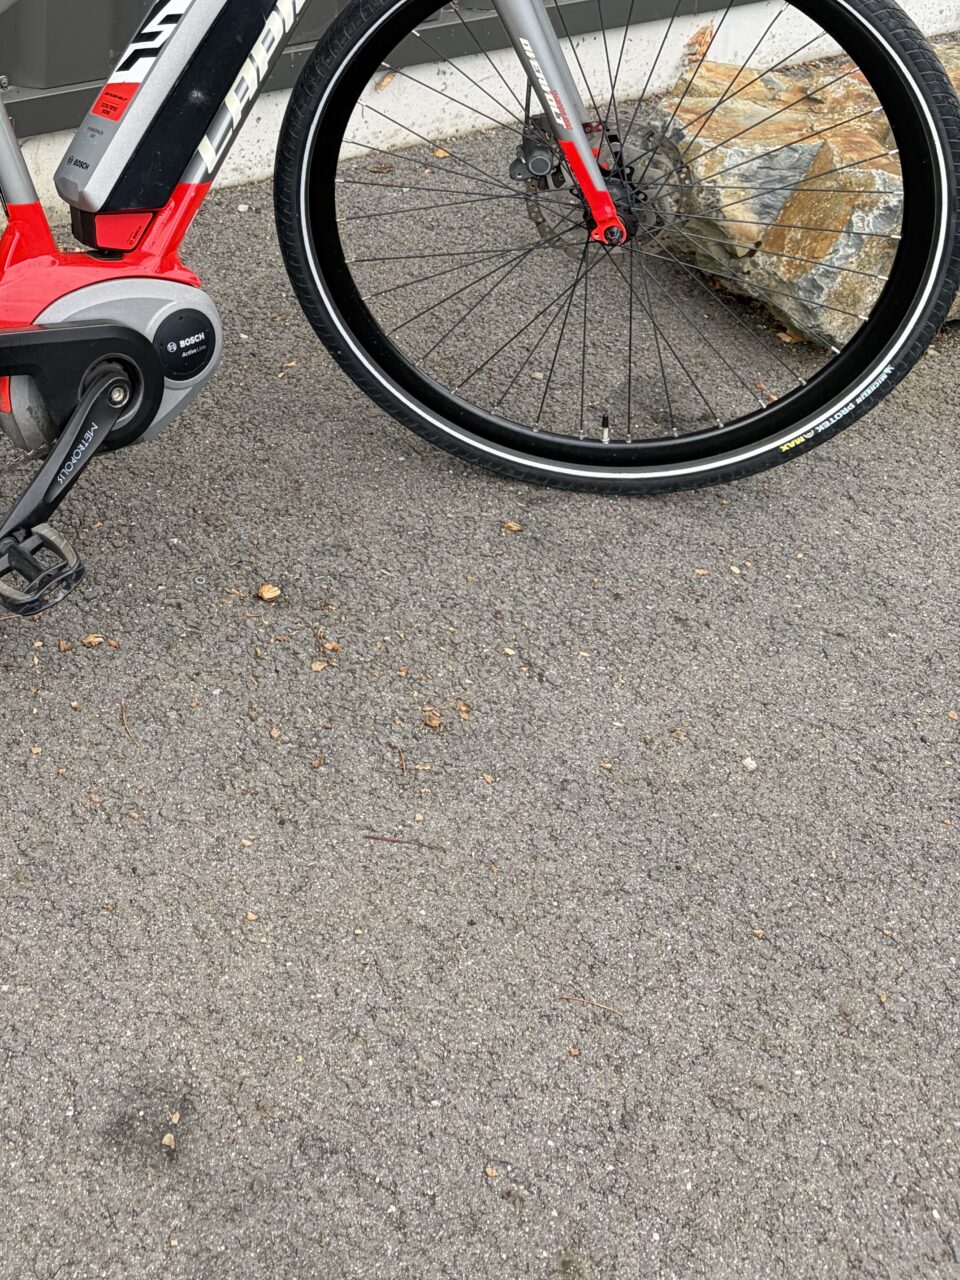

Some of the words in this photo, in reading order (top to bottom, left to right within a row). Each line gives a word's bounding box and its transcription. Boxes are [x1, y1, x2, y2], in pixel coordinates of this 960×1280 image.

[519, 36, 568, 130] OVERVOLT
[73, 158, 90, 170] BOSCH
[179, 331, 206, 349] BOSCH
[815, 402, 856, 433] PROTEK
[57, 421, 99, 484] METROPOLIS
[779, 435, 806, 453] MAX
